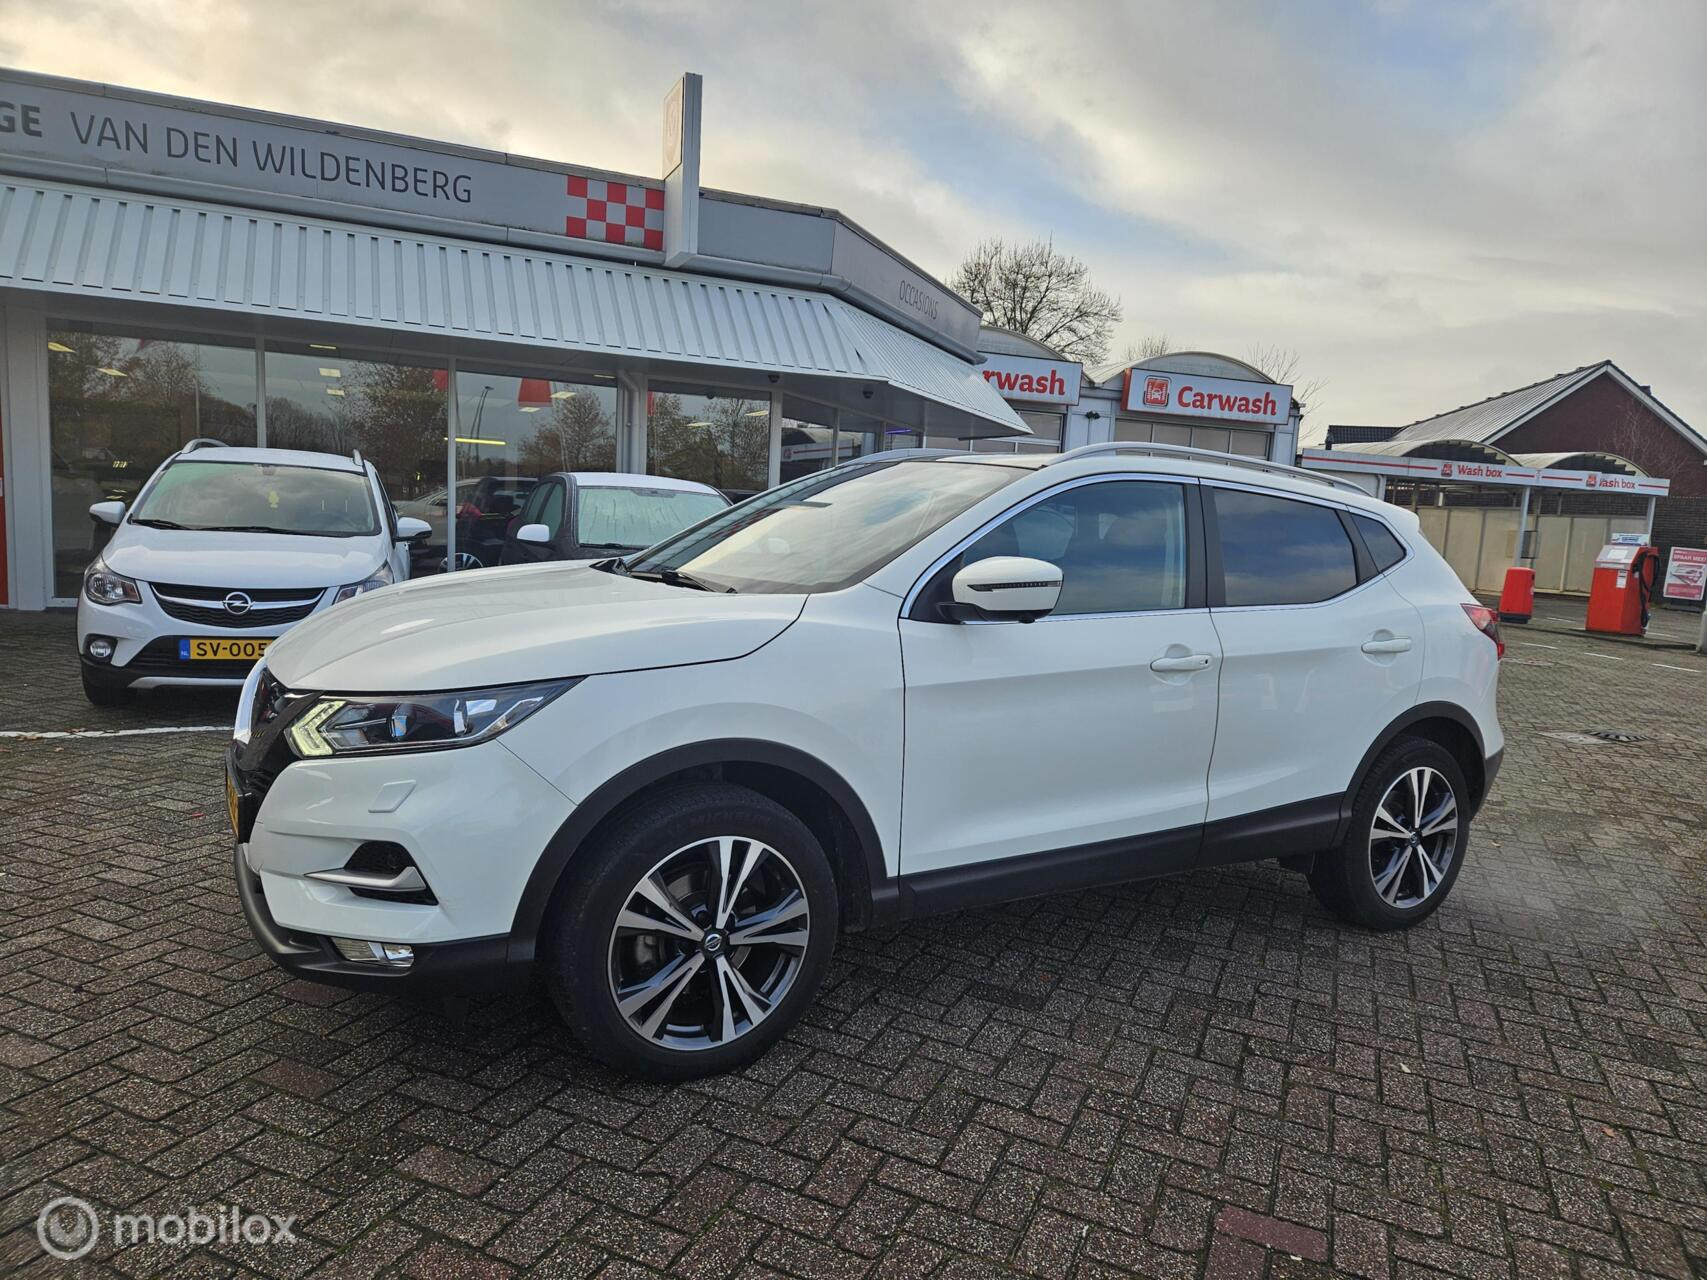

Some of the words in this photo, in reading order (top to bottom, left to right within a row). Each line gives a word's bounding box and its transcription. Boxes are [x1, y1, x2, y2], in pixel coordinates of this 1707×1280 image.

[70, 111, 148, 154] VAN
[166, 127, 238, 168] DEN
[252, 140, 472, 203] WILDENBERG
[899, 280, 938, 320] OCCASIONS
[1177, 385, 1277, 416] Carwash
[1457, 464, 1484, 477] Wash
[1486, 466, 1503, 478] box
[1621, 479, 1636, 489] box
